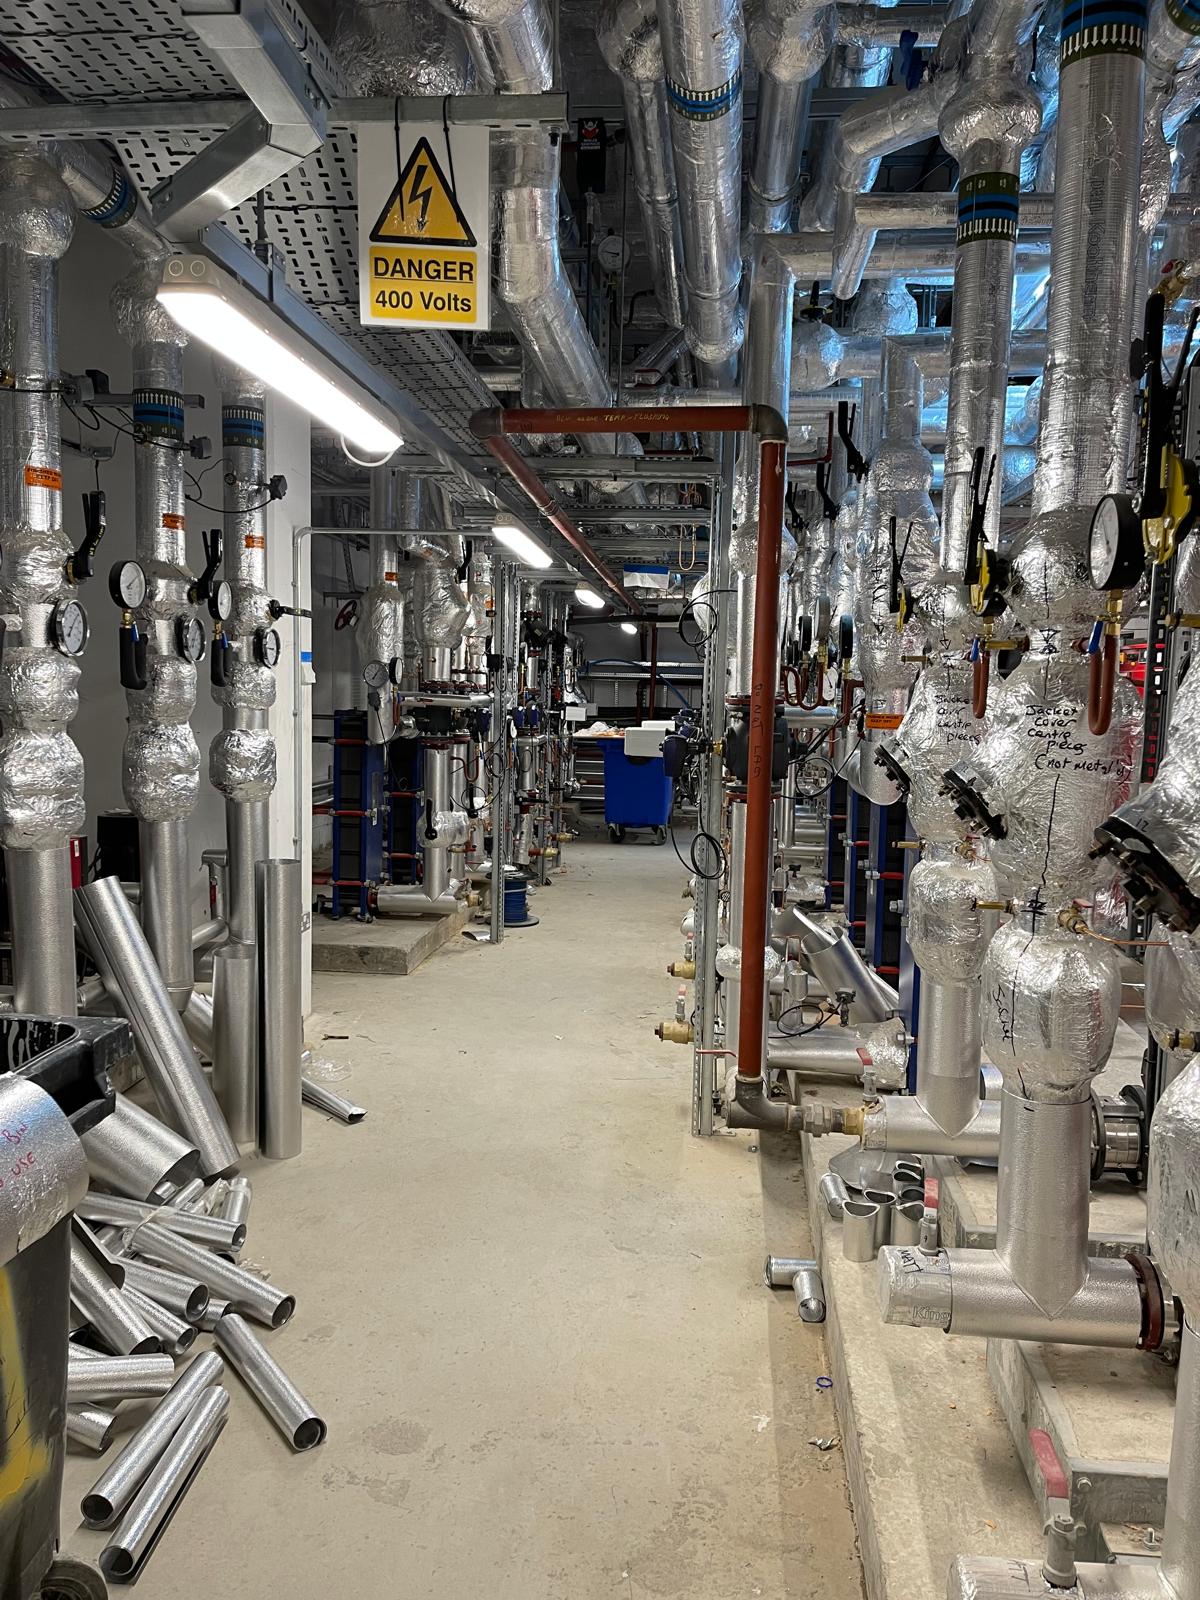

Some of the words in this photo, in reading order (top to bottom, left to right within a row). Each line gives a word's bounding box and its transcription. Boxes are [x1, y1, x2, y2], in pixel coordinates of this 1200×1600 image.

[374, 257, 474, 281] DANGER
[375, 290, 413, 309] 400
[420, 291, 471, 312] Volts
[1026, 705, 1078, 716] Jacket
[1034, 717, 1077, 727] Cover
